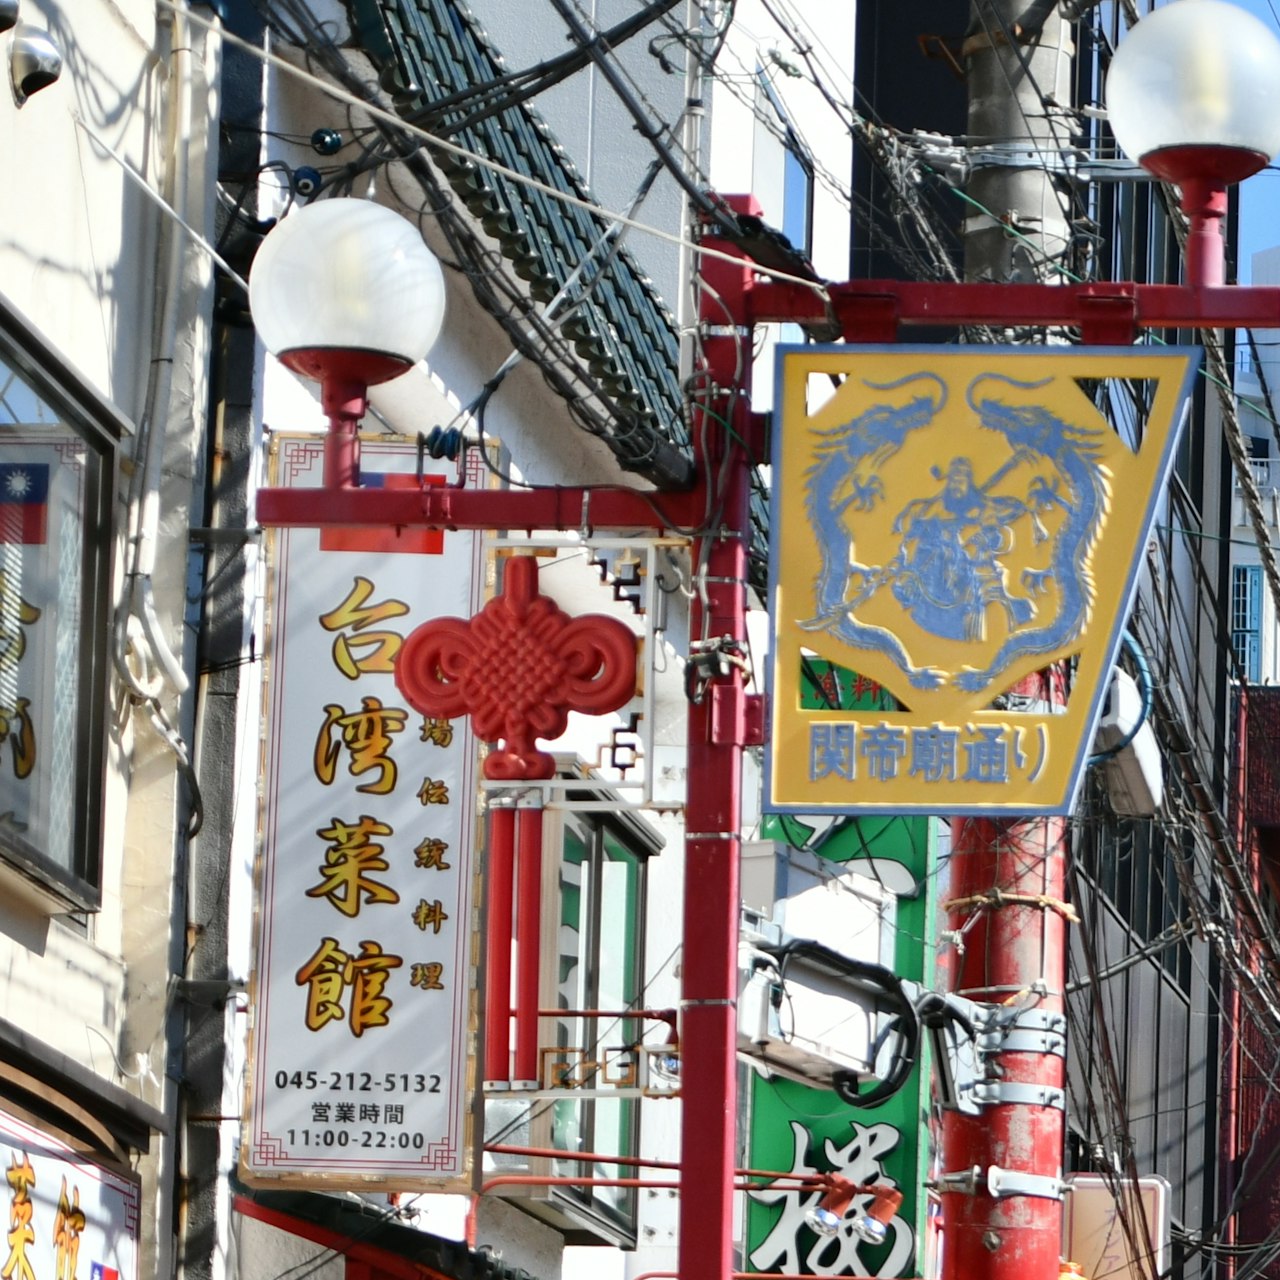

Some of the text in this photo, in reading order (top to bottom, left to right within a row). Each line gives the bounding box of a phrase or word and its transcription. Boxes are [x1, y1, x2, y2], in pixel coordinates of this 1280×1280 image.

[807, 720, 1049, 784] 関帝廟通り
[294, 576, 409, 1038] 台湾菜館
[274, 1068, 442, 1095] 045-212-5132
[311, 1101, 406, 1126] 営業時間
[287, 1128, 425, 1153] 11:00-22:00
